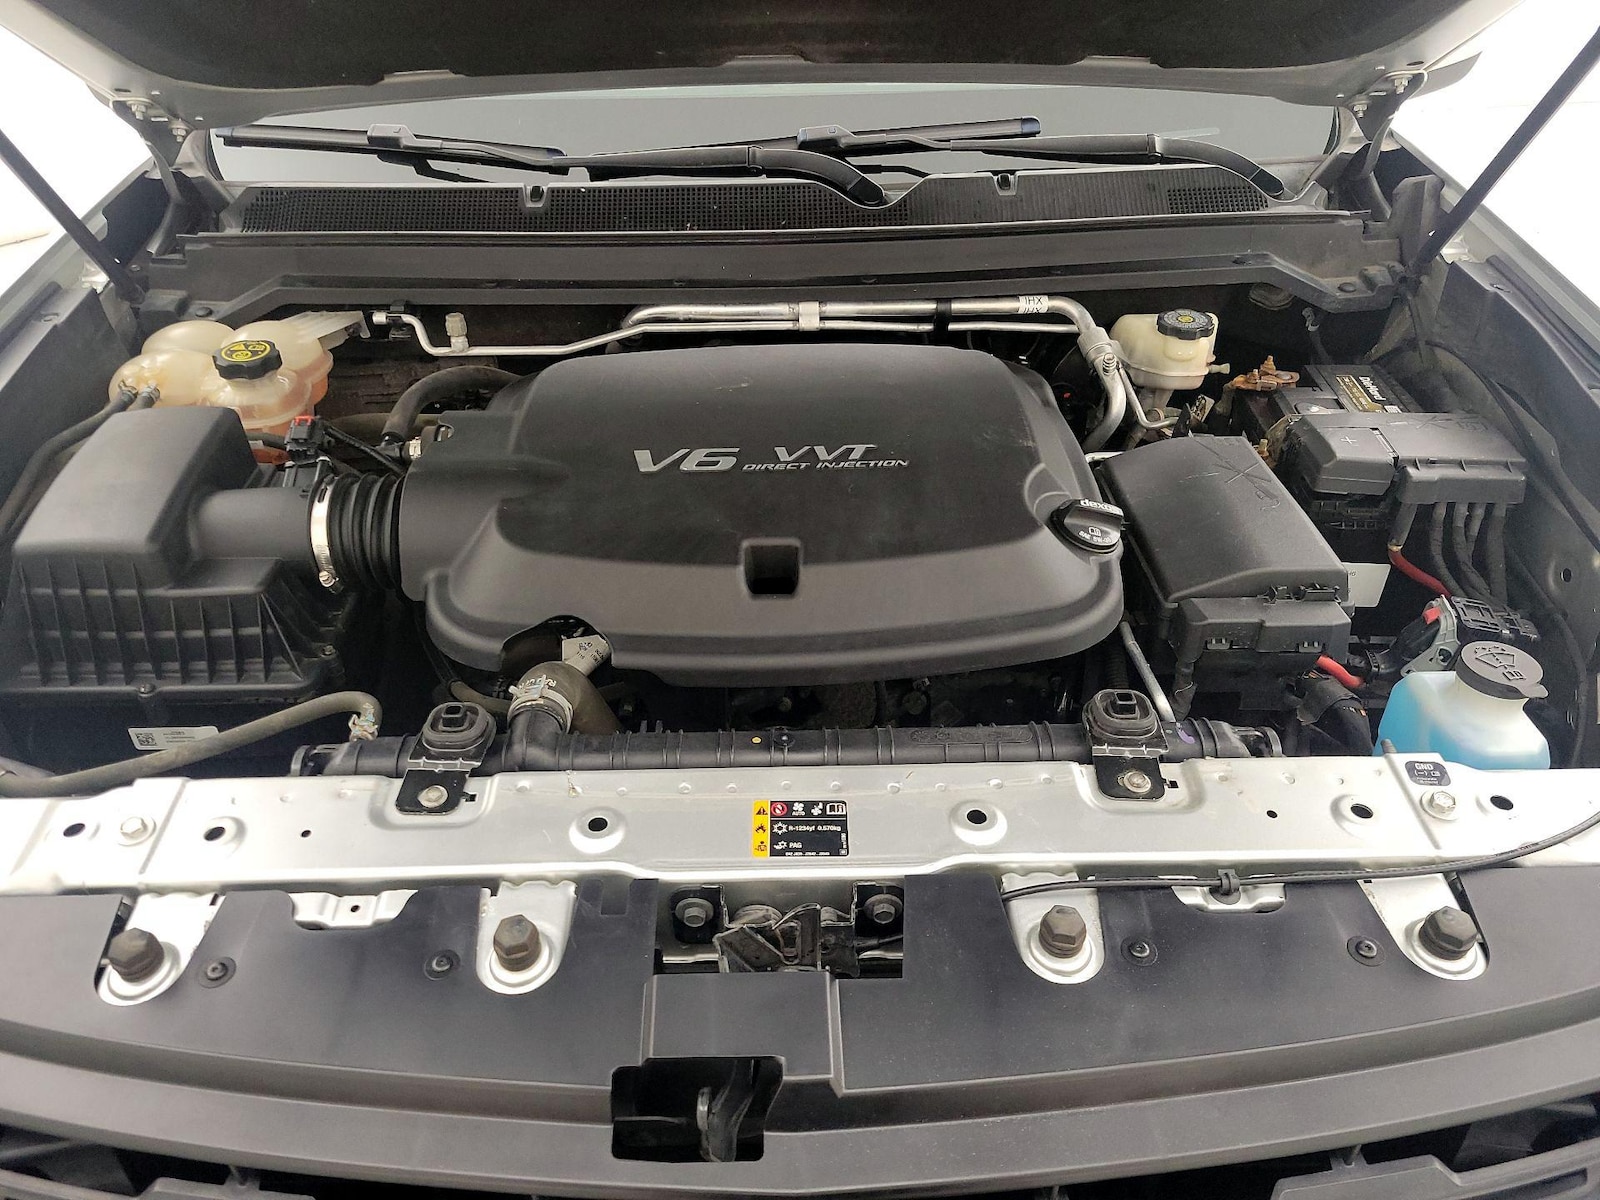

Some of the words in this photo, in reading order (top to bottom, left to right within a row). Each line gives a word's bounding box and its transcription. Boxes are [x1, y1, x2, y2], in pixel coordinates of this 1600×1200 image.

[1359, 376, 1386, 401] DieHard
[633, 447, 741, 473] V6
[773, 444, 878, 462] VVT
[742, 462, 811, 471] DIRECT
[815, 459, 909, 470] INJECTION
[1414, 762, 1434, 771] GND
